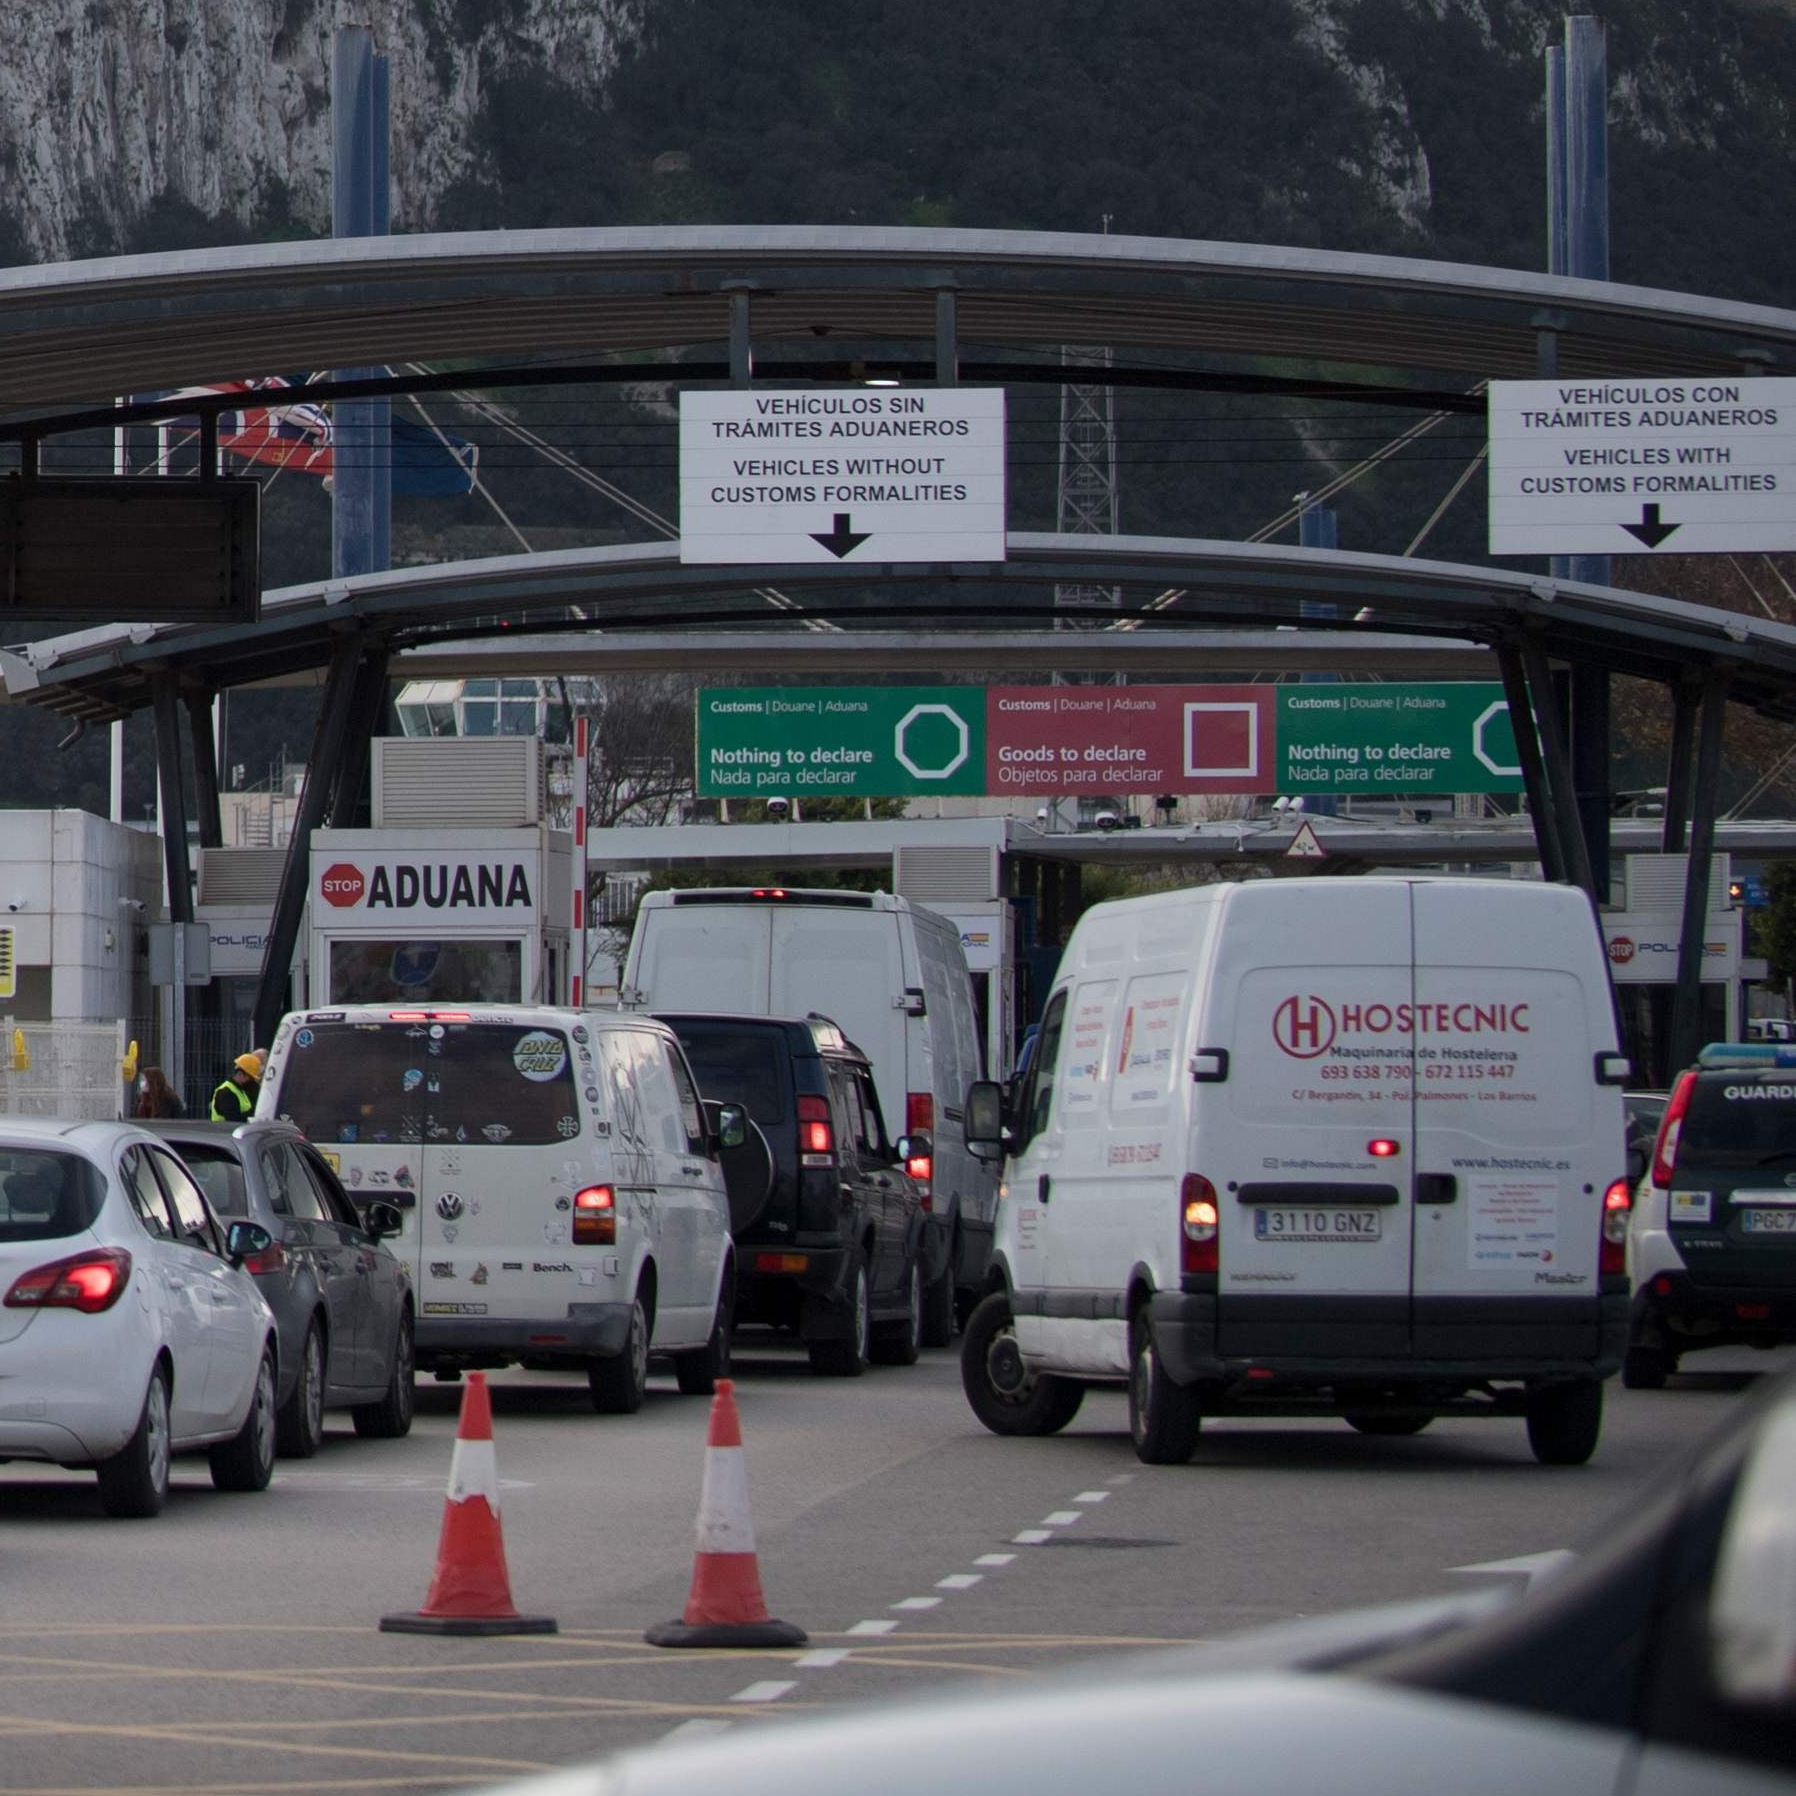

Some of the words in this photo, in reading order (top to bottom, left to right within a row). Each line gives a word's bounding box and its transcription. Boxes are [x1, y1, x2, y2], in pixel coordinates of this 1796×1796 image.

[1559, 384, 1685, 404] VEHÍCULOS
[1692, 386, 1740, 403] CON
[756, 394, 883, 414] VEHÍCULOS
[889, 397, 924, 413] SIN
[1520, 408, 1631, 428] TRÁMITES
[1638, 409, 1778, 426] ADUANEROS
[712, 418, 823, 438] TRÁMITES
[829, 419, 969, 437] ADUANEROS
[1564, 448, 1671, 465] VEHICLES
[1676, 447, 1731, 464] WITH
[733, 459, 840, 476] VEHICLES
[846, 458, 946, 475] WITHOUT
[711, 486, 817, 503] CUSTOMS
[823, 484, 967, 502] FORMALITIES
[1520, 476, 1626, 494] CUSTOMS
[1633, 475, 1777, 493] FORMALITIES
[710, 700, 763, 713] Customs
[772, 700, 816, 712] Douane
[824, 700, 868, 712] Aduana
[998, 699, 1051, 711] Customs
[1060, 698, 1104, 711] Douane
[1113, 698, 1157, 711] Aduana
[1288, 697, 1340, 709] Customs
[1350, 697, 1393, 709] Douane
[1403, 697, 1446, 709] Aduana
[710, 747, 781, 767] Nothing
[786, 749, 805, 764] to
[810, 747, 873, 764] declare
[998, 745, 1055, 762] Goods
[1060, 747, 1079, 762] to
[1084, 745, 1147, 762] declare
[1288, 744, 1359, 764] Nothing
[1364, 746, 1383, 760] to
[1388, 744, 1451, 760] declare
[710, 768, 751, 784] Nada
[757, 771, 791, 788] para
[796, 767, 857, 784] declarar
[998, 766, 1058, 786] Objetos
[1063, 769, 1097, 785] para
[1102, 766, 1164, 783] declarar
[1288, 765, 1329, 781] Nada
[1335, 768, 1369, 784] para
[1374, 764, 1435, 781] declarar
[323, 879, 361, 893] STOP
[366, 864, 533, 908] ADUANA
[1609, 944, 1633, 954] STOP
[1341, 1003, 1530, 1033] HOSTECNIC
[1330, 1046, 1414, 1061] Maquinaria
[1418, 1047, 1437, 1060] de
[1320, 1065, 1349, 1079] 693
[1352, 1065, 1381, 1079] 638
[1384, 1065, 1411, 1079] 790
[1425, 1065, 1452, 1079] 672
[1458, 1065, 1484, 1079] 115
[1488, 1065, 1515, 1079] 447
[1271, 1212, 1327, 1233] 3110
[1334, 1212, 1375, 1233] GNZ
[1751, 1212, 1785, 1230] PGC
